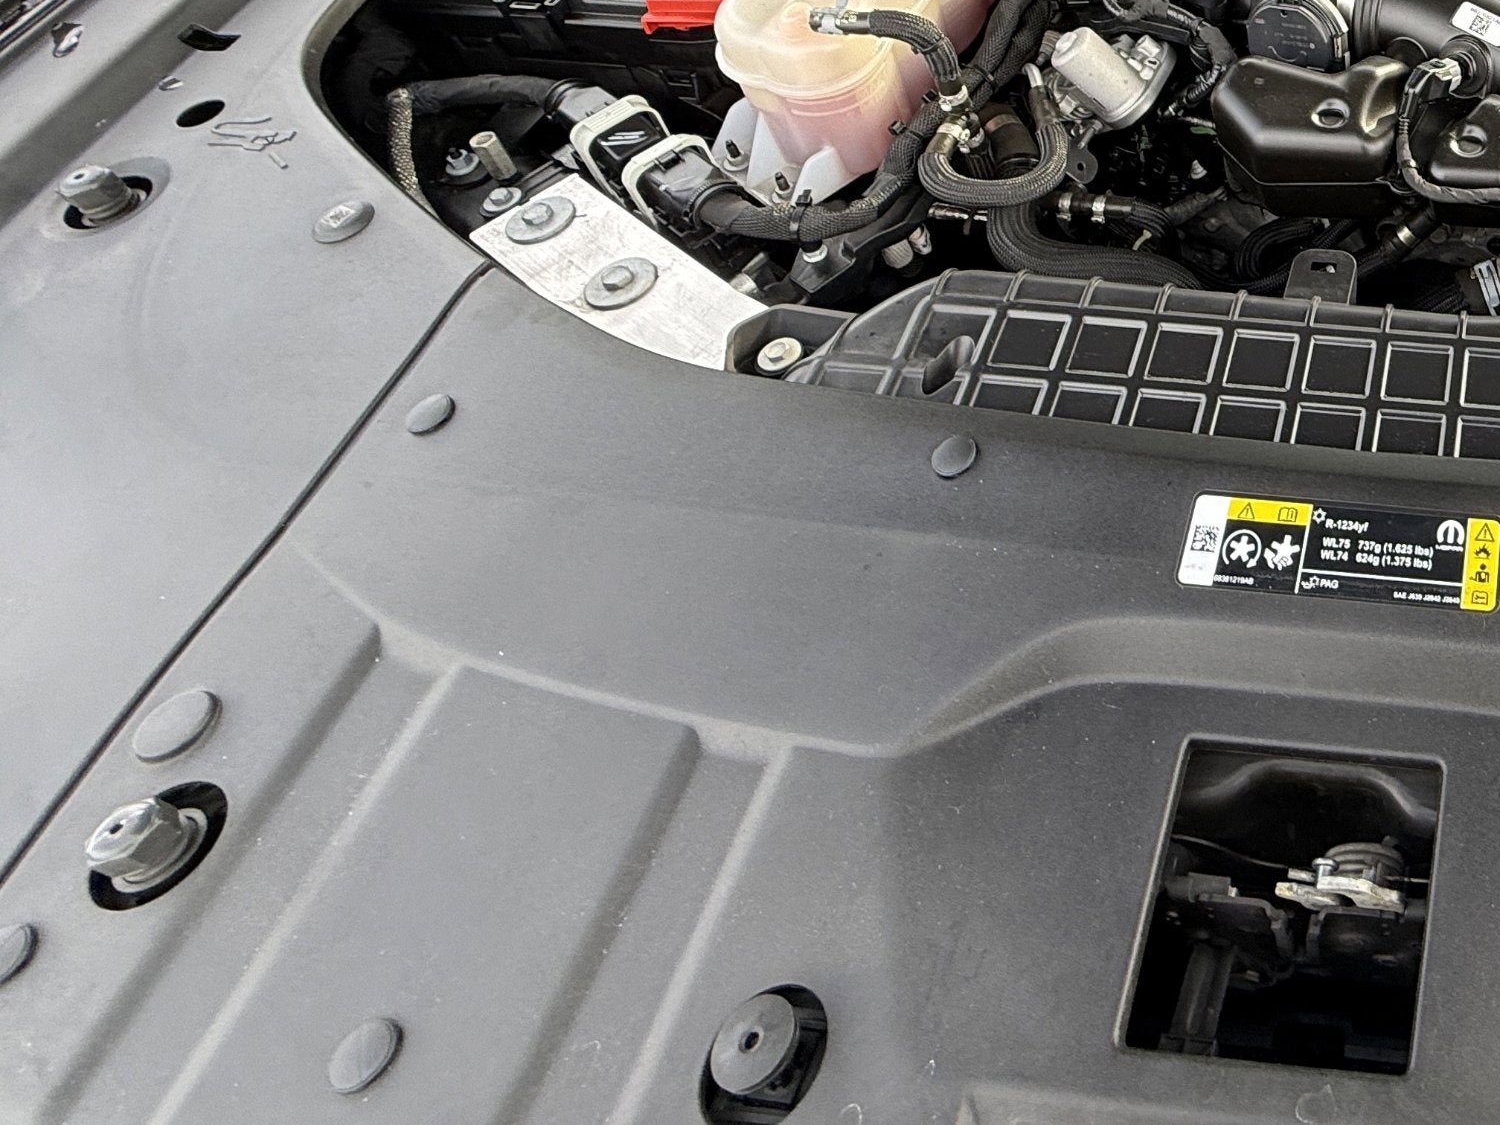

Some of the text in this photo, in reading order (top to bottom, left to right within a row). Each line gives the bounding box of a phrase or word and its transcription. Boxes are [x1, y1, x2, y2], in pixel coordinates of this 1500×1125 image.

[1325, 518, 1369, 534] R-1234yf
[1322, 536, 1434, 558] WL75 737g (1.625 lbs)
[1320, 549, 1433, 571] WL74 624g (1.375 lbs)
[1319, 578, 1339, 589] PAG
